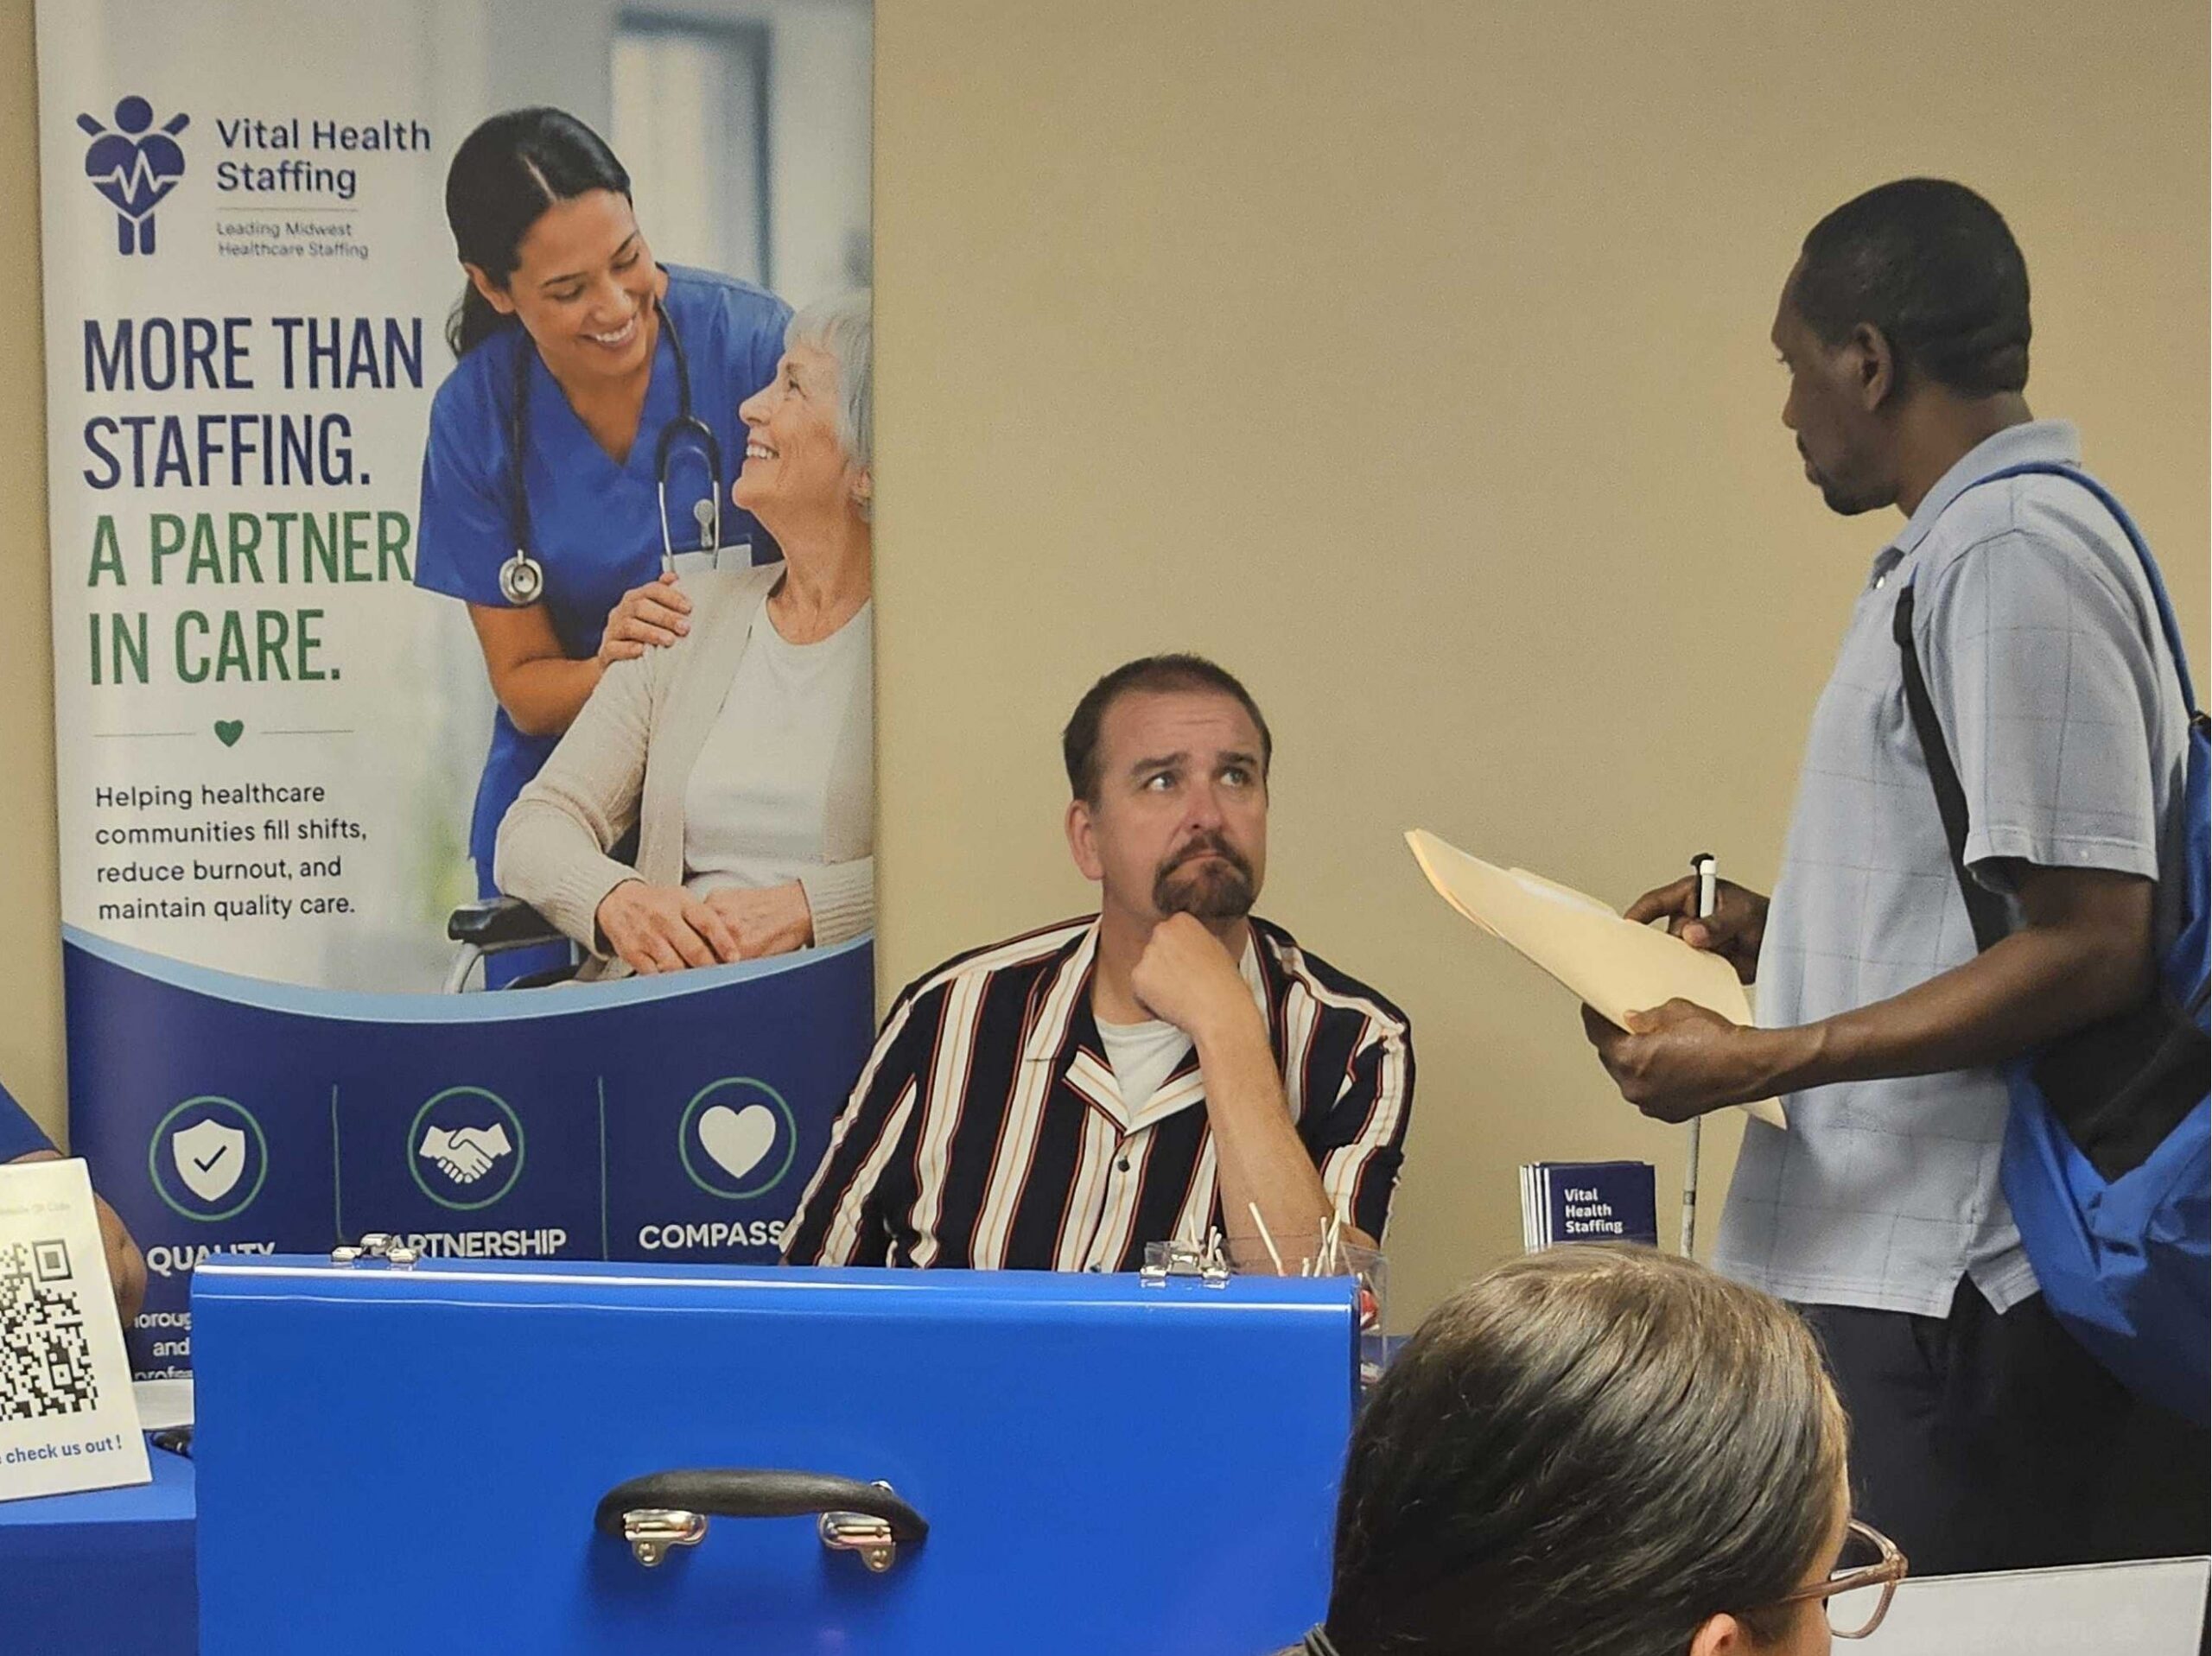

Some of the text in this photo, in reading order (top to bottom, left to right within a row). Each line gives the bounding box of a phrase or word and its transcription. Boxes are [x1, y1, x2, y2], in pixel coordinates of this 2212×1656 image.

[216, 117, 430, 151] Vital Health
[217, 159, 356, 200] Staffing
[216, 221, 352, 239] Leading Midwest
[219, 241, 369, 261] Healthcare Staffing
[84, 317, 423, 393] MORE THAN
[83, 413, 371, 490] STAFFING.
[87, 511, 413, 588] A PARTNER
[89, 608, 341, 686] IN CARE.
[96, 783, 326, 811] Helping healthcare
[95, 817, 367, 845] communities fill shifts,
[97, 855, 342, 883] reduce burnout, and
[99, 894, 355, 922] maintain quality care.
[1564, 1188, 1599, 1202] Vital
[1565, 1204, 1612, 1218] Health
[1565, 1220, 1624, 1234] Staffing
[385, 1228, 567, 1258] ARTNERSHIP
[6, 1443, 59, 1464] check
[61, 1443, 82, 1456] us
